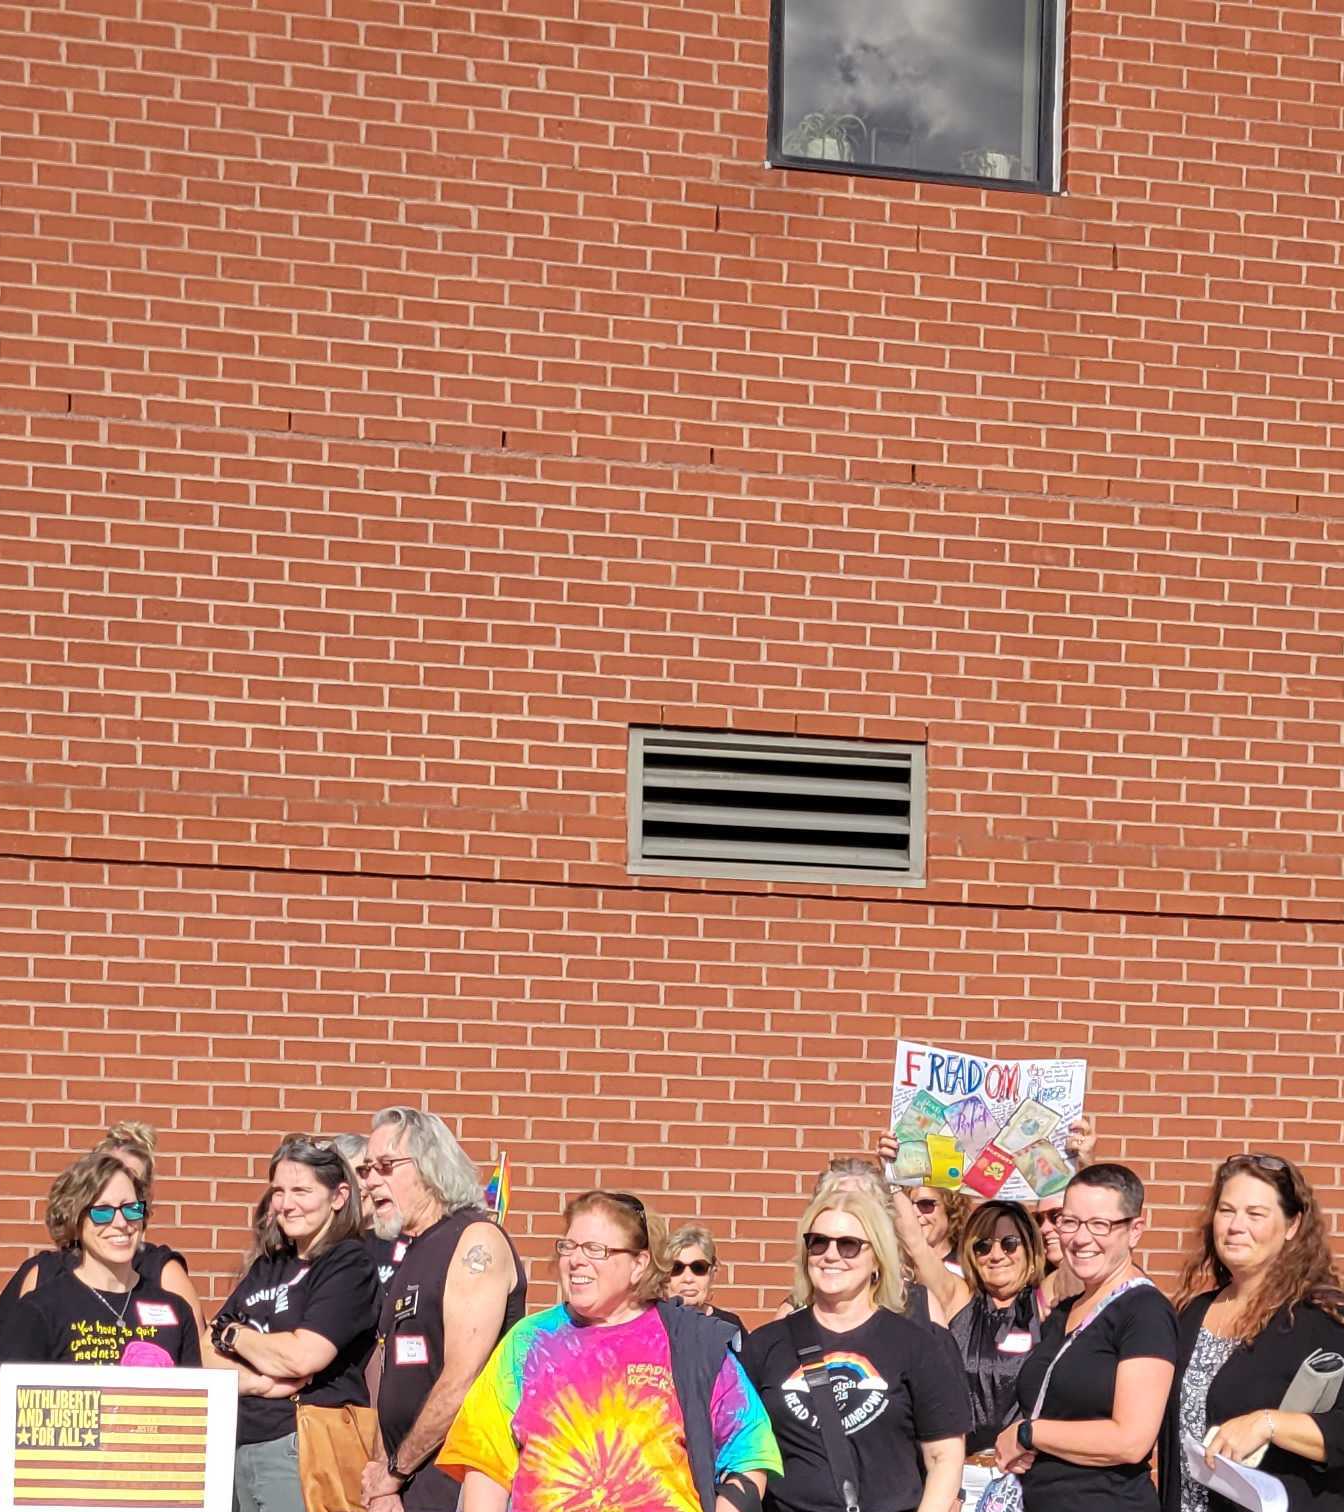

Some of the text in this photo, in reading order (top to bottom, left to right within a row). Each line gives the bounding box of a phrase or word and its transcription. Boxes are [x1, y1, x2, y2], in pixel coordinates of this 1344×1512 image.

[95, 1320, 117, 1336] have
[121, 1327, 133, 1337] to
[136, 1325, 158, 1341] quit
[70, 1334, 117, 1351] confusing
[74, 1347, 120, 1362] madness
[17, 1408, 99, 1429] AND JUSTICE
[784, 1392, 810, 1420] READ
[841, 1390, 884, 1430] AINBOW!
[31, 1427, 83, 1447] FOR ALL
